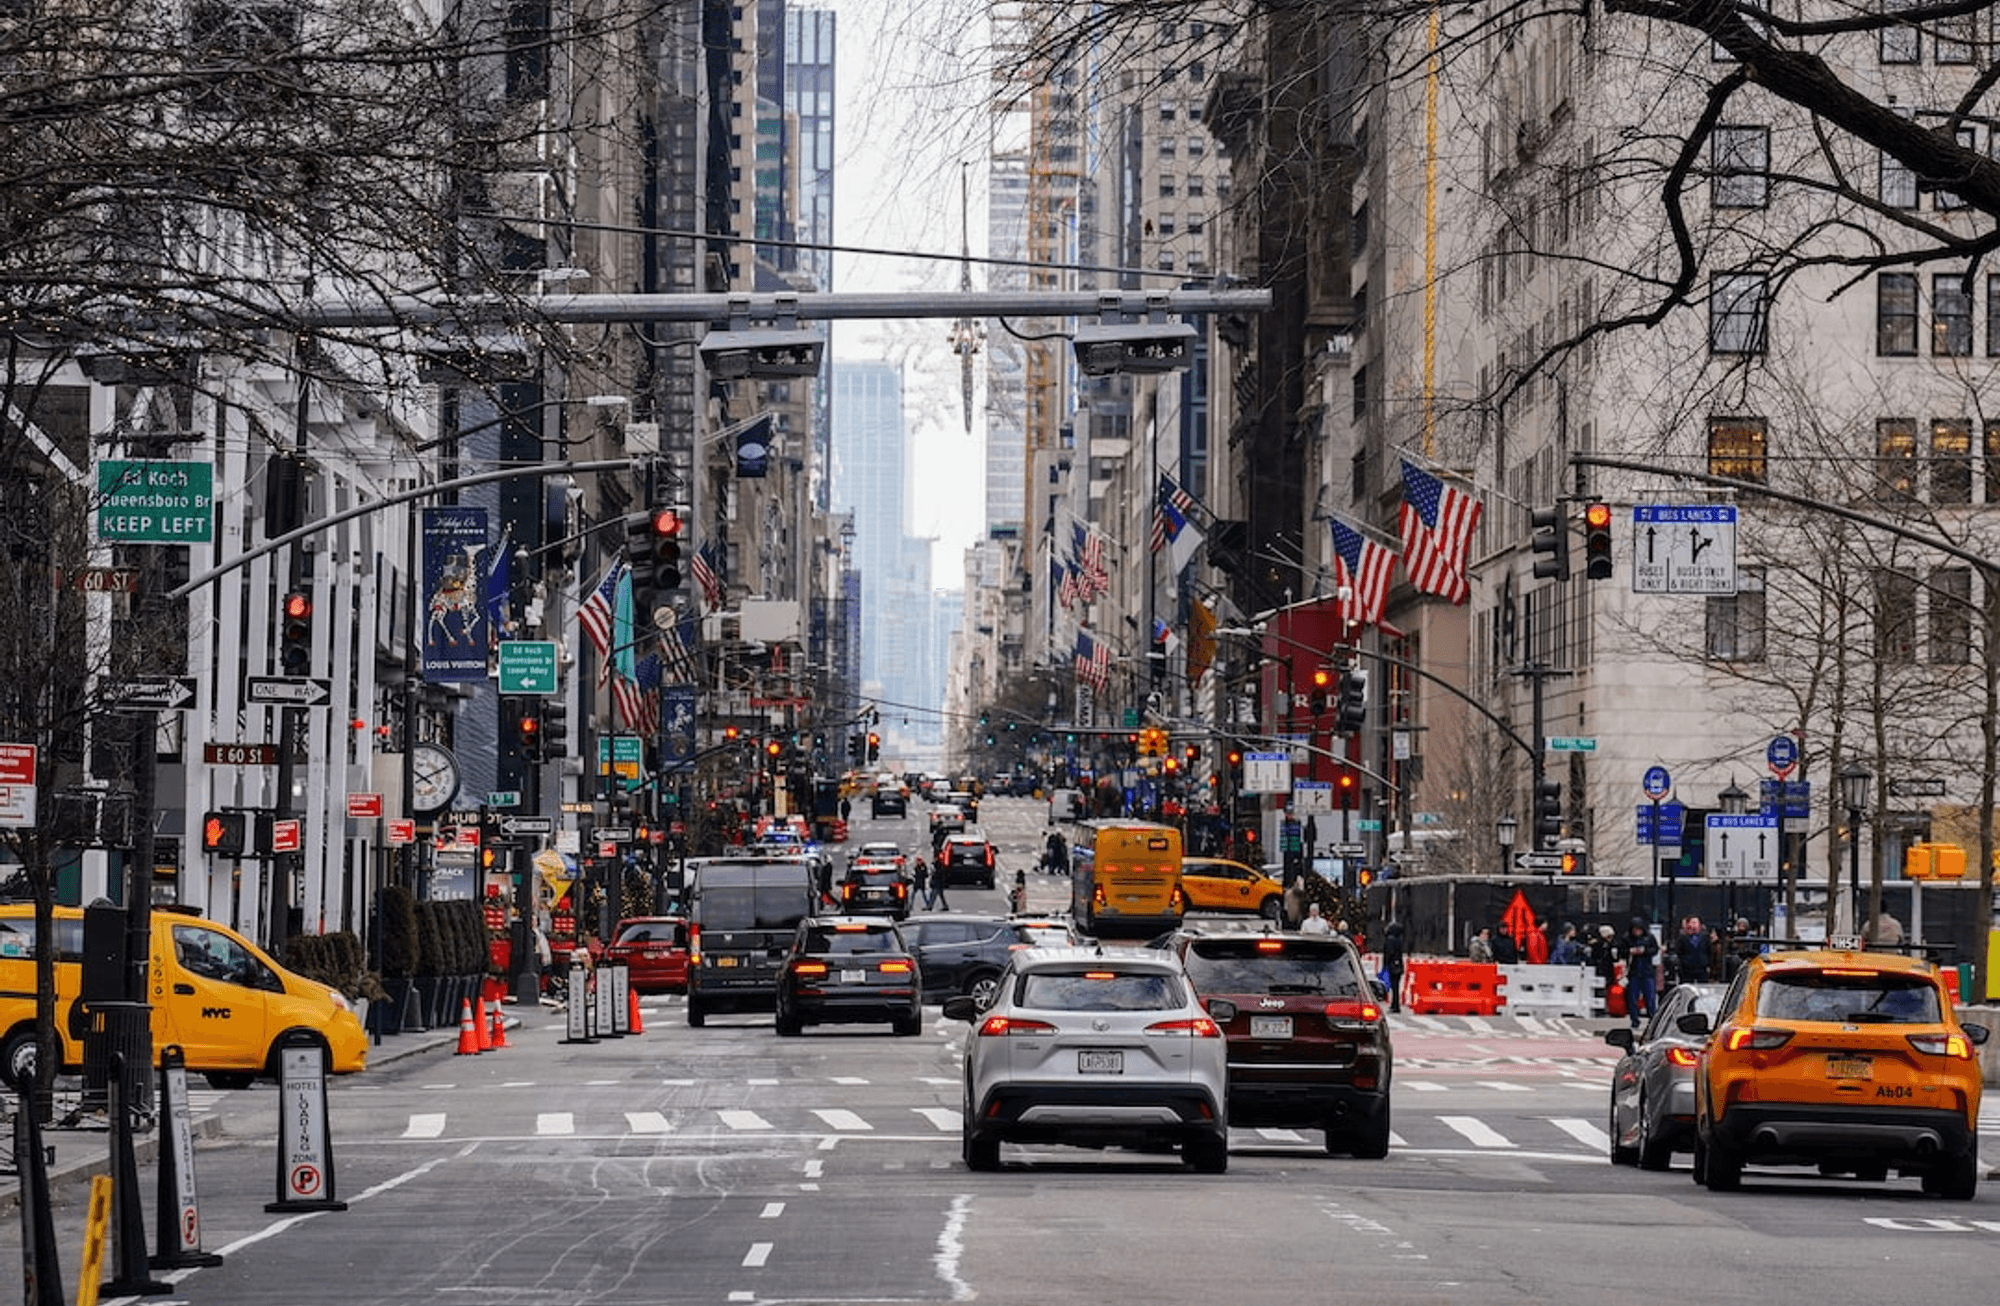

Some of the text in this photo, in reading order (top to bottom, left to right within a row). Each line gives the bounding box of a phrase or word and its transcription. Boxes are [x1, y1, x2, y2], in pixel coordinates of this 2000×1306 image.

[148, 470, 189, 486] Koch
[100, 493, 211, 507] Queensboro Br
[1658, 510, 1713, 520] BUS LANES
[103, 516, 206, 533] KEEP LEFT
[85, 571, 103, 590] 60
[256, 685, 317, 697] ONE WAY
[216, 748, 224, 762] E
[228, 748, 245, 762] 60
[1260, 997, 1285, 1009] Jeep
[201, 1007, 231, 1019] NYC
[287, 1082, 318, 1090] HOTEL
[299, 1093, 310, 1152] LOADING
[292, 1154, 318, 1163] ZONE
